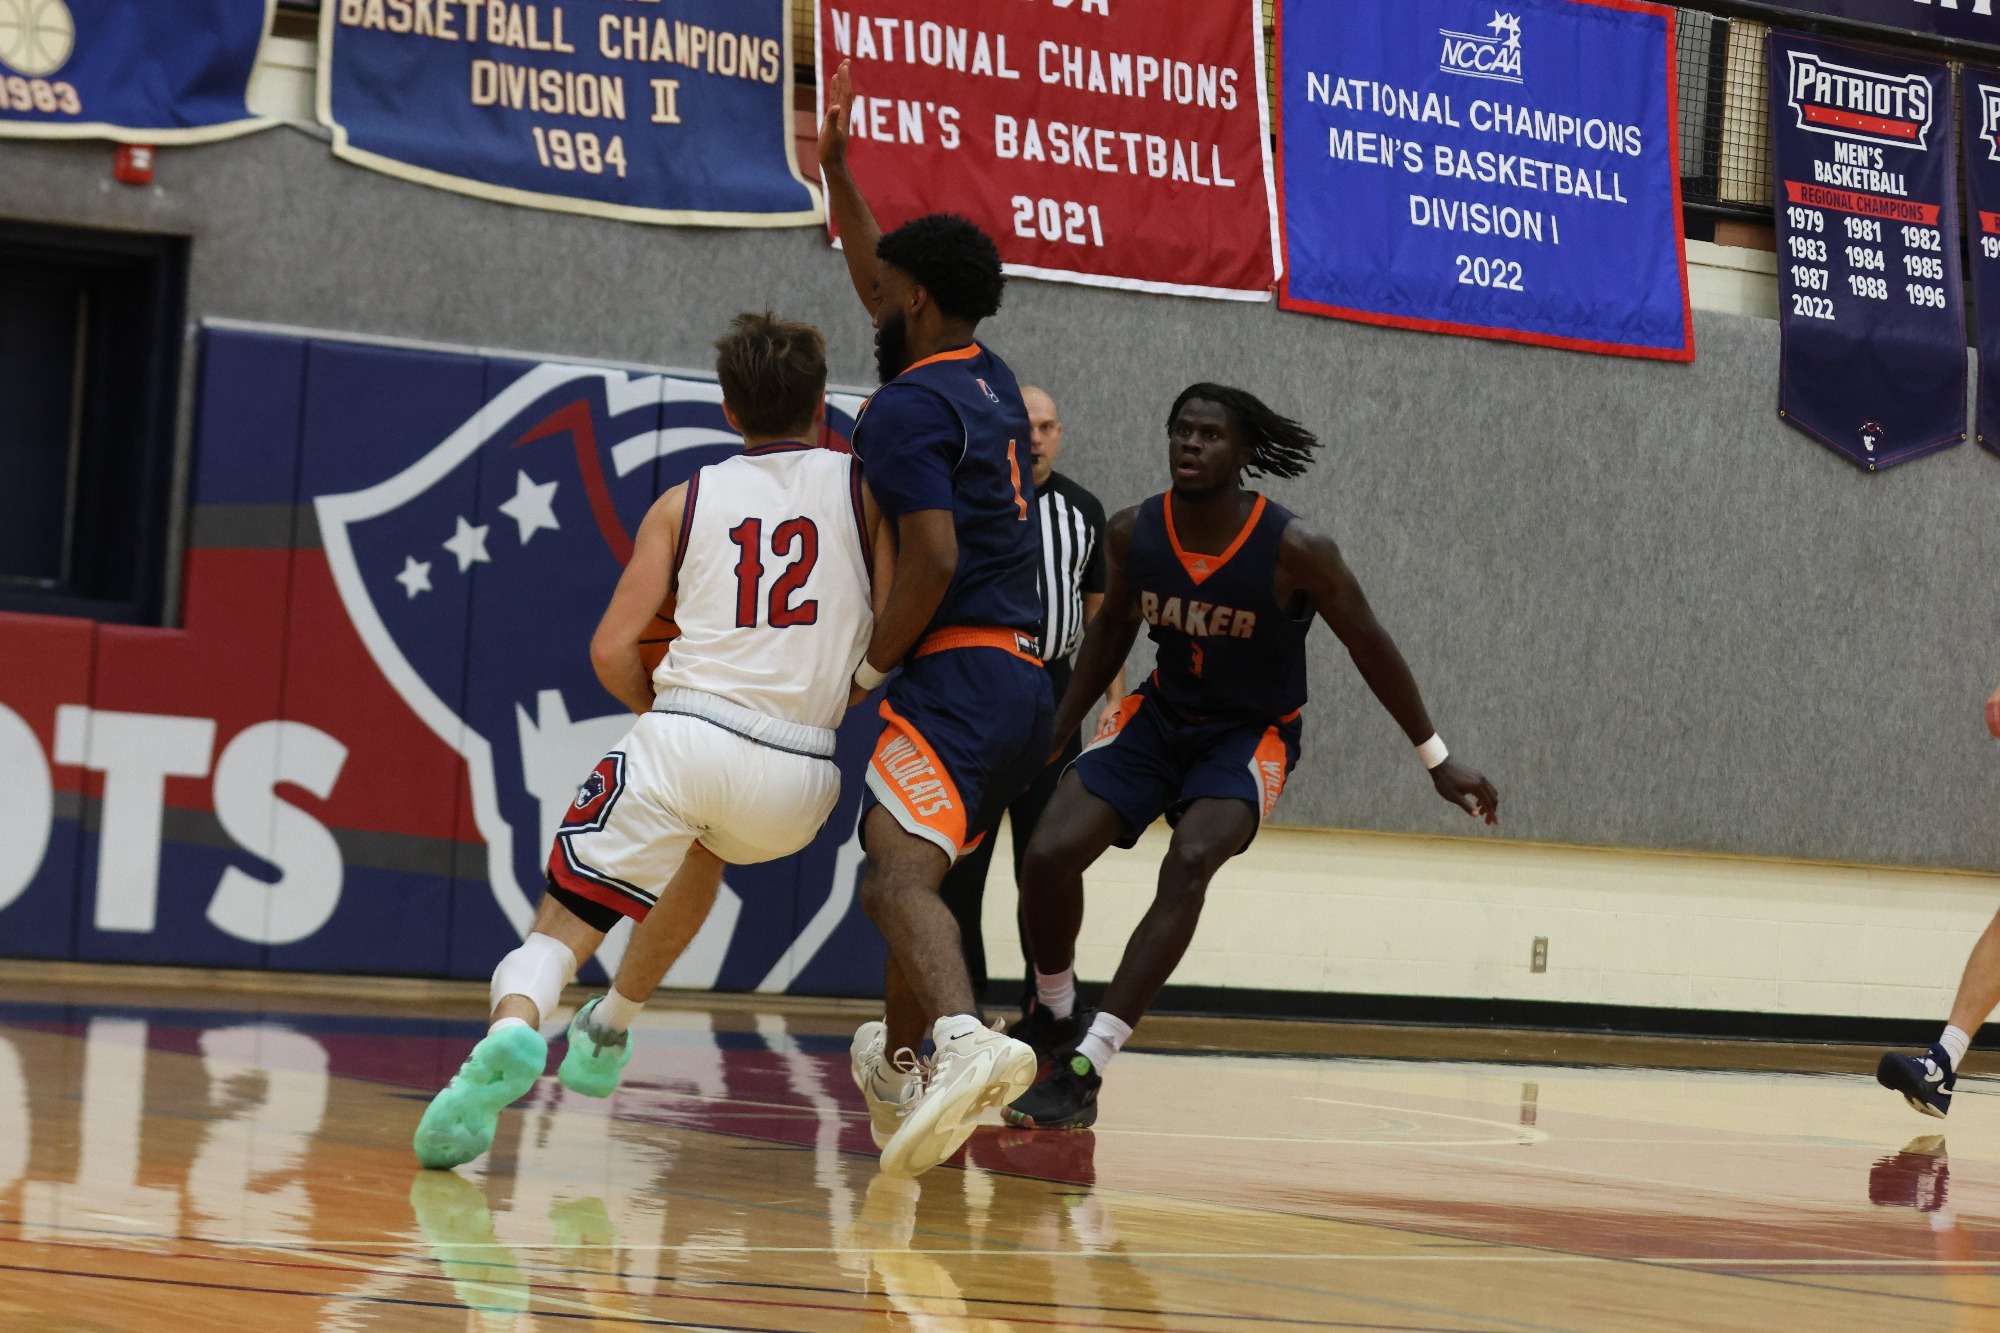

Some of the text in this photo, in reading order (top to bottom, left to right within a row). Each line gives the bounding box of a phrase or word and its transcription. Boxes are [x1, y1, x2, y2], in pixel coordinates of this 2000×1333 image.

[340, 0, 780, 84] BASKETBALL CHAMPIONS
[831, 8, 1238, 111] NATIONAL CHAMPIONS
[1440, 38, 1522, 76] NCCAA
[0, 73, 82, 116] 1983
[471, 59, 681, 124] DIVISION II
[1307, 71, 1642, 157] NATIONAL CHAMPIONS
[1796, 62, 1926, 121] PATRIOTS
[532, 126, 627, 178] 1984
[994, 114, 1236, 188] BASKETBALL
[1329, 127, 1628, 204] MEN'S BASKETBALL
[1834, 140, 1884, 170] MEN'S
[1801, 186, 1924, 221] REGIONAL CHAMPIONS
[1813, 159, 1908, 197] BASKETBALL
[1010, 195, 1104, 247] 2021
[1409, 194, 1559, 245] DIVISION I
[1786, 206, 1942, 252] 1979 1981 1982
[1455, 254, 1524, 292] 2022
[1787, 235, 1944, 280] 1983 1984 1985
[1790, 264, 1946, 309] 1987 1988 1996
[1791, 293, 1836, 321] 2022
[1006, 438, 1028, 521] 1
[729, 515, 819, 629] 12
[1140, 590, 1257, 639] BAKER
[878, 734, 953, 817] WILDCATS
